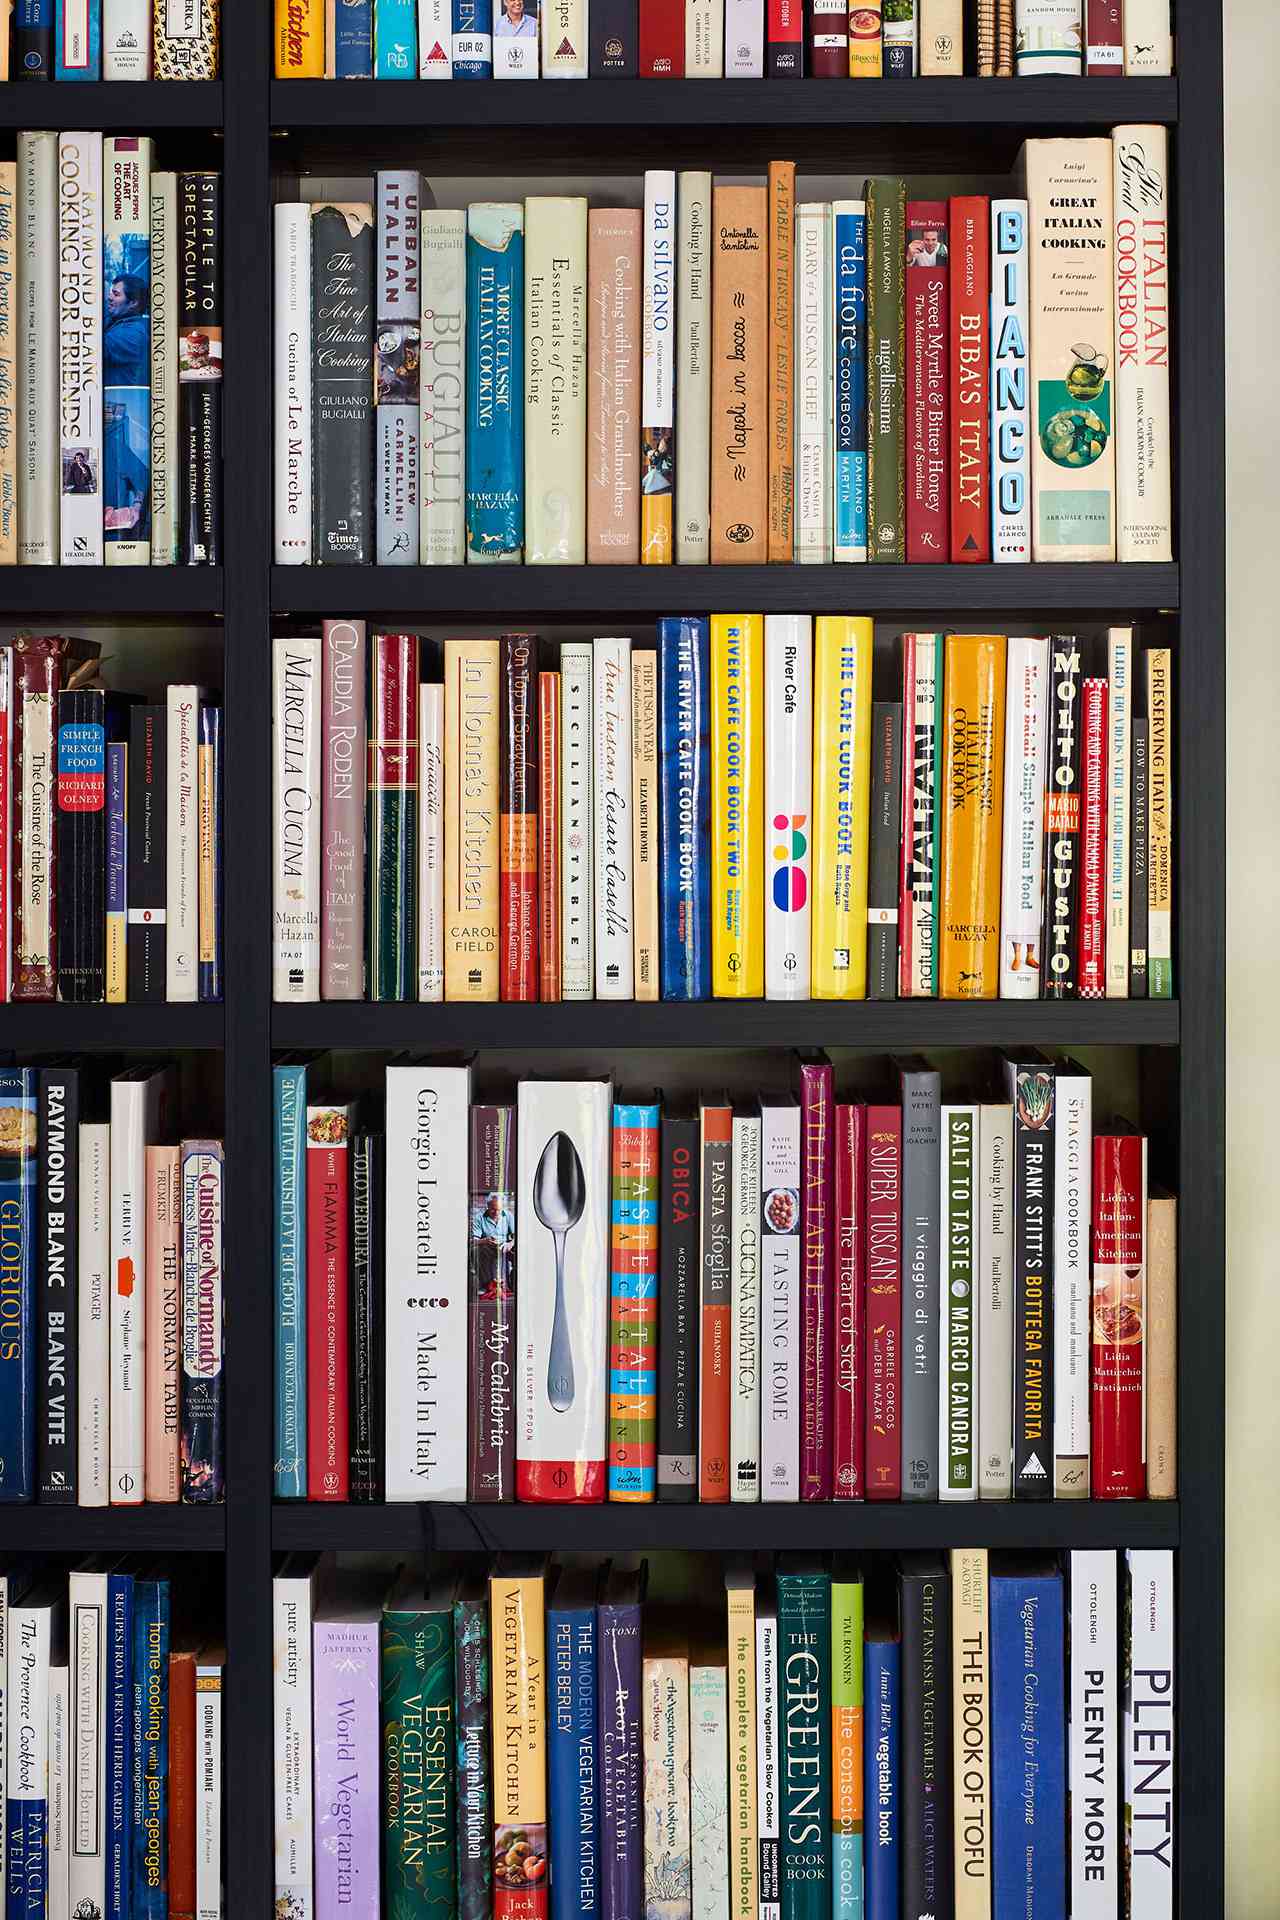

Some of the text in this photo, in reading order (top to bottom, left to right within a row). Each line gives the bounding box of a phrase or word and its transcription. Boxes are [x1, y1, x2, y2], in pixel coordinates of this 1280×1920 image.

[455, 61, 482, 72] Chicago
[458, 42, 472, 52] EUR
[114, 163, 121, 173] OF
[185, 184, 196, 311] SPECTACULAR
[204, 184, 215, 311] SIMPLE TO
[386, 184, 399, 304] ITALIAN
[405, 195, 417, 293] URBAN
[883, 208, 891, 293] NIGELLA LAWSON
[1041, 239, 1106, 249] COOKING
[1044, 218, 1103, 228] ITALIAN
[1049, 197, 1097, 208] GREAT
[61, 145, 80, 438] COOKING FOR FRIENDS
[82, 191, 97, 391] RAYMOND BLANC
[479, 266, 493, 427] ITALIAN COOKING
[496, 285, 509, 411] MORE CLASSIC
[528, 276, 543, 404] Italian Cooking
[548, 258, 569, 436] Essentials of Classic
[996, 212, 1025, 515] BIANCO
[1116, 220, 1137, 368] COOKBOOK
[1141, 218, 1167, 368] ITALIAN
[287, 333, 302, 515] Cucina of Le Marche
[613, 255, 630, 517] Cooking with Italian Grandmothers
[877, 339, 893, 434] nigellissima
[925, 280, 943, 513] Sweet Myrtle & Bitter Honey
[961, 314, 981, 509] BIBA'S ITALY
[283, 652, 312, 878] MARCELLA CUCINA
[328, 624, 359, 799] CLAUDIA RODEN
[677, 640, 694, 892] THE RIVER CAFE COOK BOOK
[784, 646, 797, 714] River Cafe
[1151, 668, 1165, 813] PRESERVING ITALY
[32, 752, 45, 905] The Cuisine of the Rose
[464, 657, 492, 911] In Nonna's Kitchen
[570, 686, 579, 945] SICILIAN TABLE
[1050, 653, 1080, 973] MOLTO GUSTO
[48, 1085, 65, 1445] RAYMOND BLANC BLANC VITE
[410, 1088, 438, 1275] Giorgio Locatelli
[672, 1148, 695, 1224] OBICÀ
[706, 1160, 729, 1290] PASTA sfoglia
[870, 1146, 896, 1280] SUPER TUSCAN
[163, 1243, 178, 1434] THE NORMAN TABLE
[193, 1173, 221, 1375] Cuisine of Normandy
[772, 1248, 789, 1422] TASTING ROME
[910, 1216, 928, 1375] il viaggio di vetri
[952, 1121, 970, 1457] SALT TO TASTE MARCO CANORA
[1024, 1143, 1043, 1439] FRANK STITT'S BOTTEGA FAVORITA
[410, 1332, 438, 1480] Made In Italy
[17, 1620, 38, 1791] The Provence Cookbook
[283, 1603, 301, 1688] pure artistry
[504, 1589, 521, 1816] VEGETARIAN KITCHEN
[145, 1622, 163, 1886] home cooking with jean-georges
[331, 1699, 359, 1905] World Vegetarian
[387, 1734, 399, 1828] COOKBOOK
[402, 1694, 423, 1867] VEGETARIAN
[424, 1705, 450, 1855] ESSENTIAL
[578, 1622, 594, 1911] THE MODERN VEGETARIAN KITCHEN
[786, 1652, 821, 1845] GREENS
[840, 1705, 856, 1908] the conscious cook
[875, 1667, 892, 1846] Annie Bell's vegetable book
[962, 1632, 984, 1877] THE BOOK OF TOFU
[1085, 1670, 1104, 1881] PLENTY MORE
[1133, 1670, 1171, 1868] PLENTY
